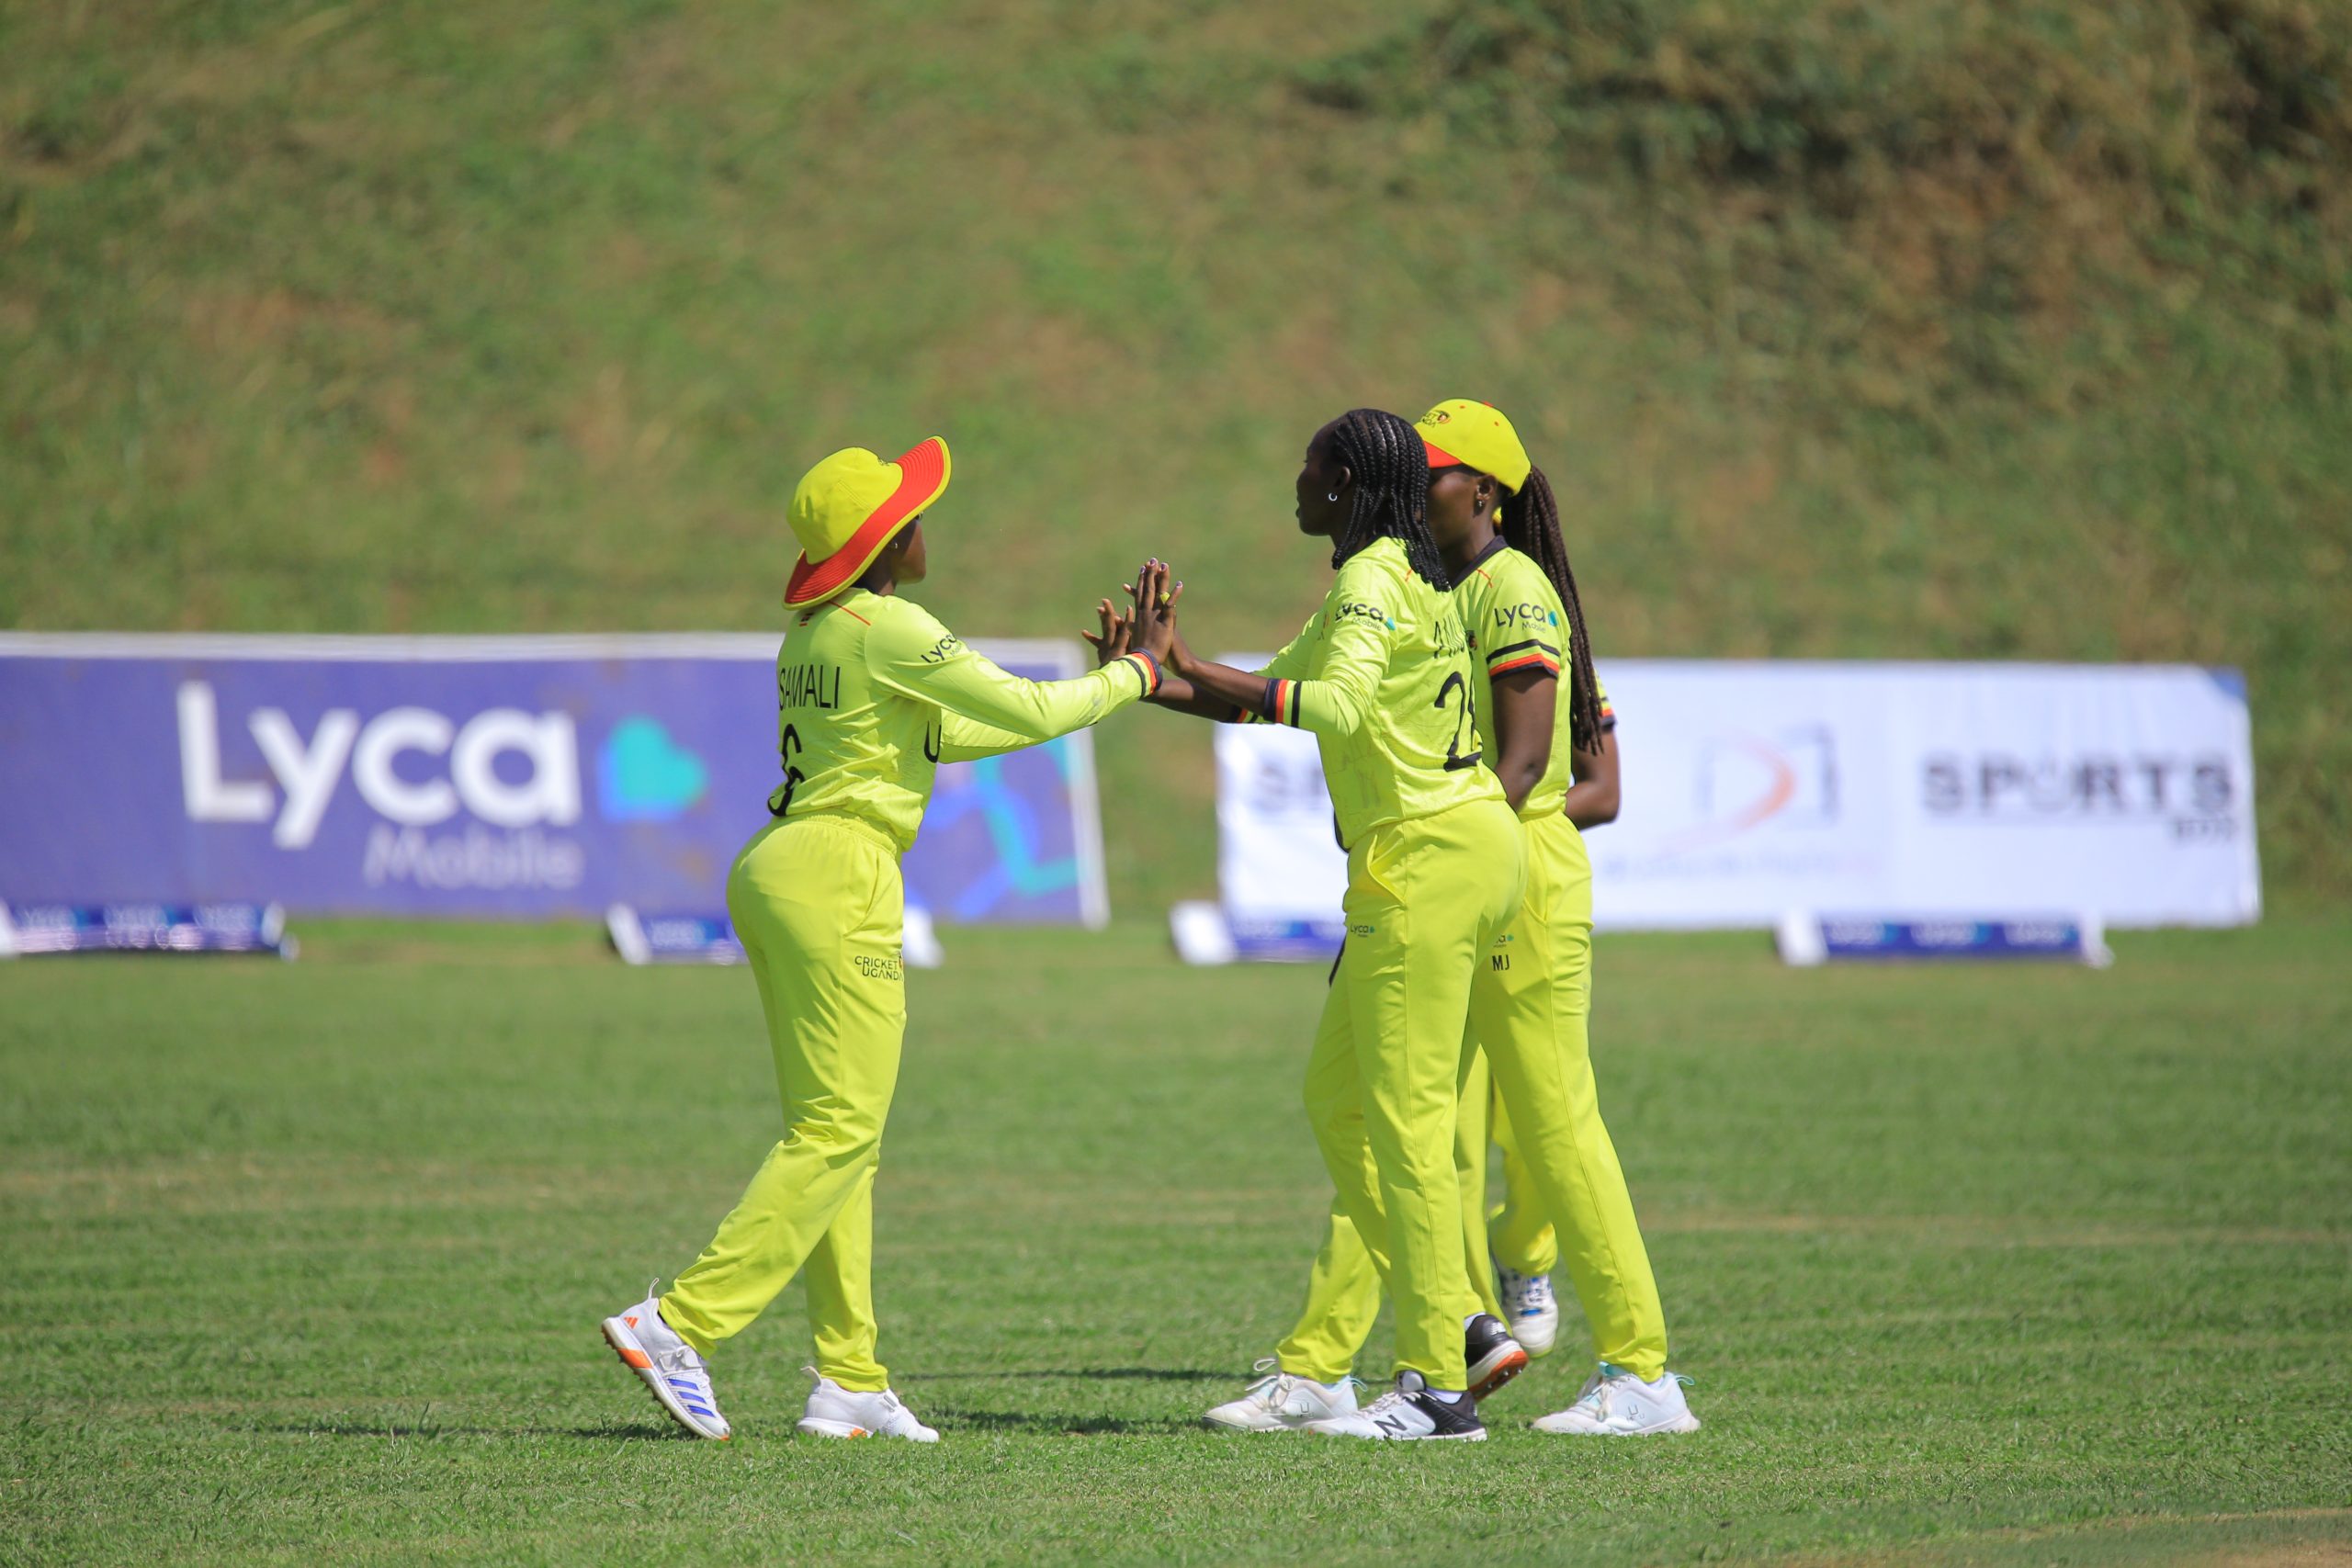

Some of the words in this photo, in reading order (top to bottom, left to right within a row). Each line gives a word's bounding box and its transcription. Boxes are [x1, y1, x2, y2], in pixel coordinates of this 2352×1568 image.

[1336, 603, 1384, 622] Lyca
[1494, 603, 1545, 627] Lyca
[921, 634, 957, 663] Lyca
[1434, 671, 1483, 772] 2
[177, 680, 584, 851] Lyca
[363, 830, 585, 888] Mobile
[854, 955, 898, 970] CRICKET
[862, 967, 903, 981] UGANDA
[1492, 954, 1510, 971] MJ
